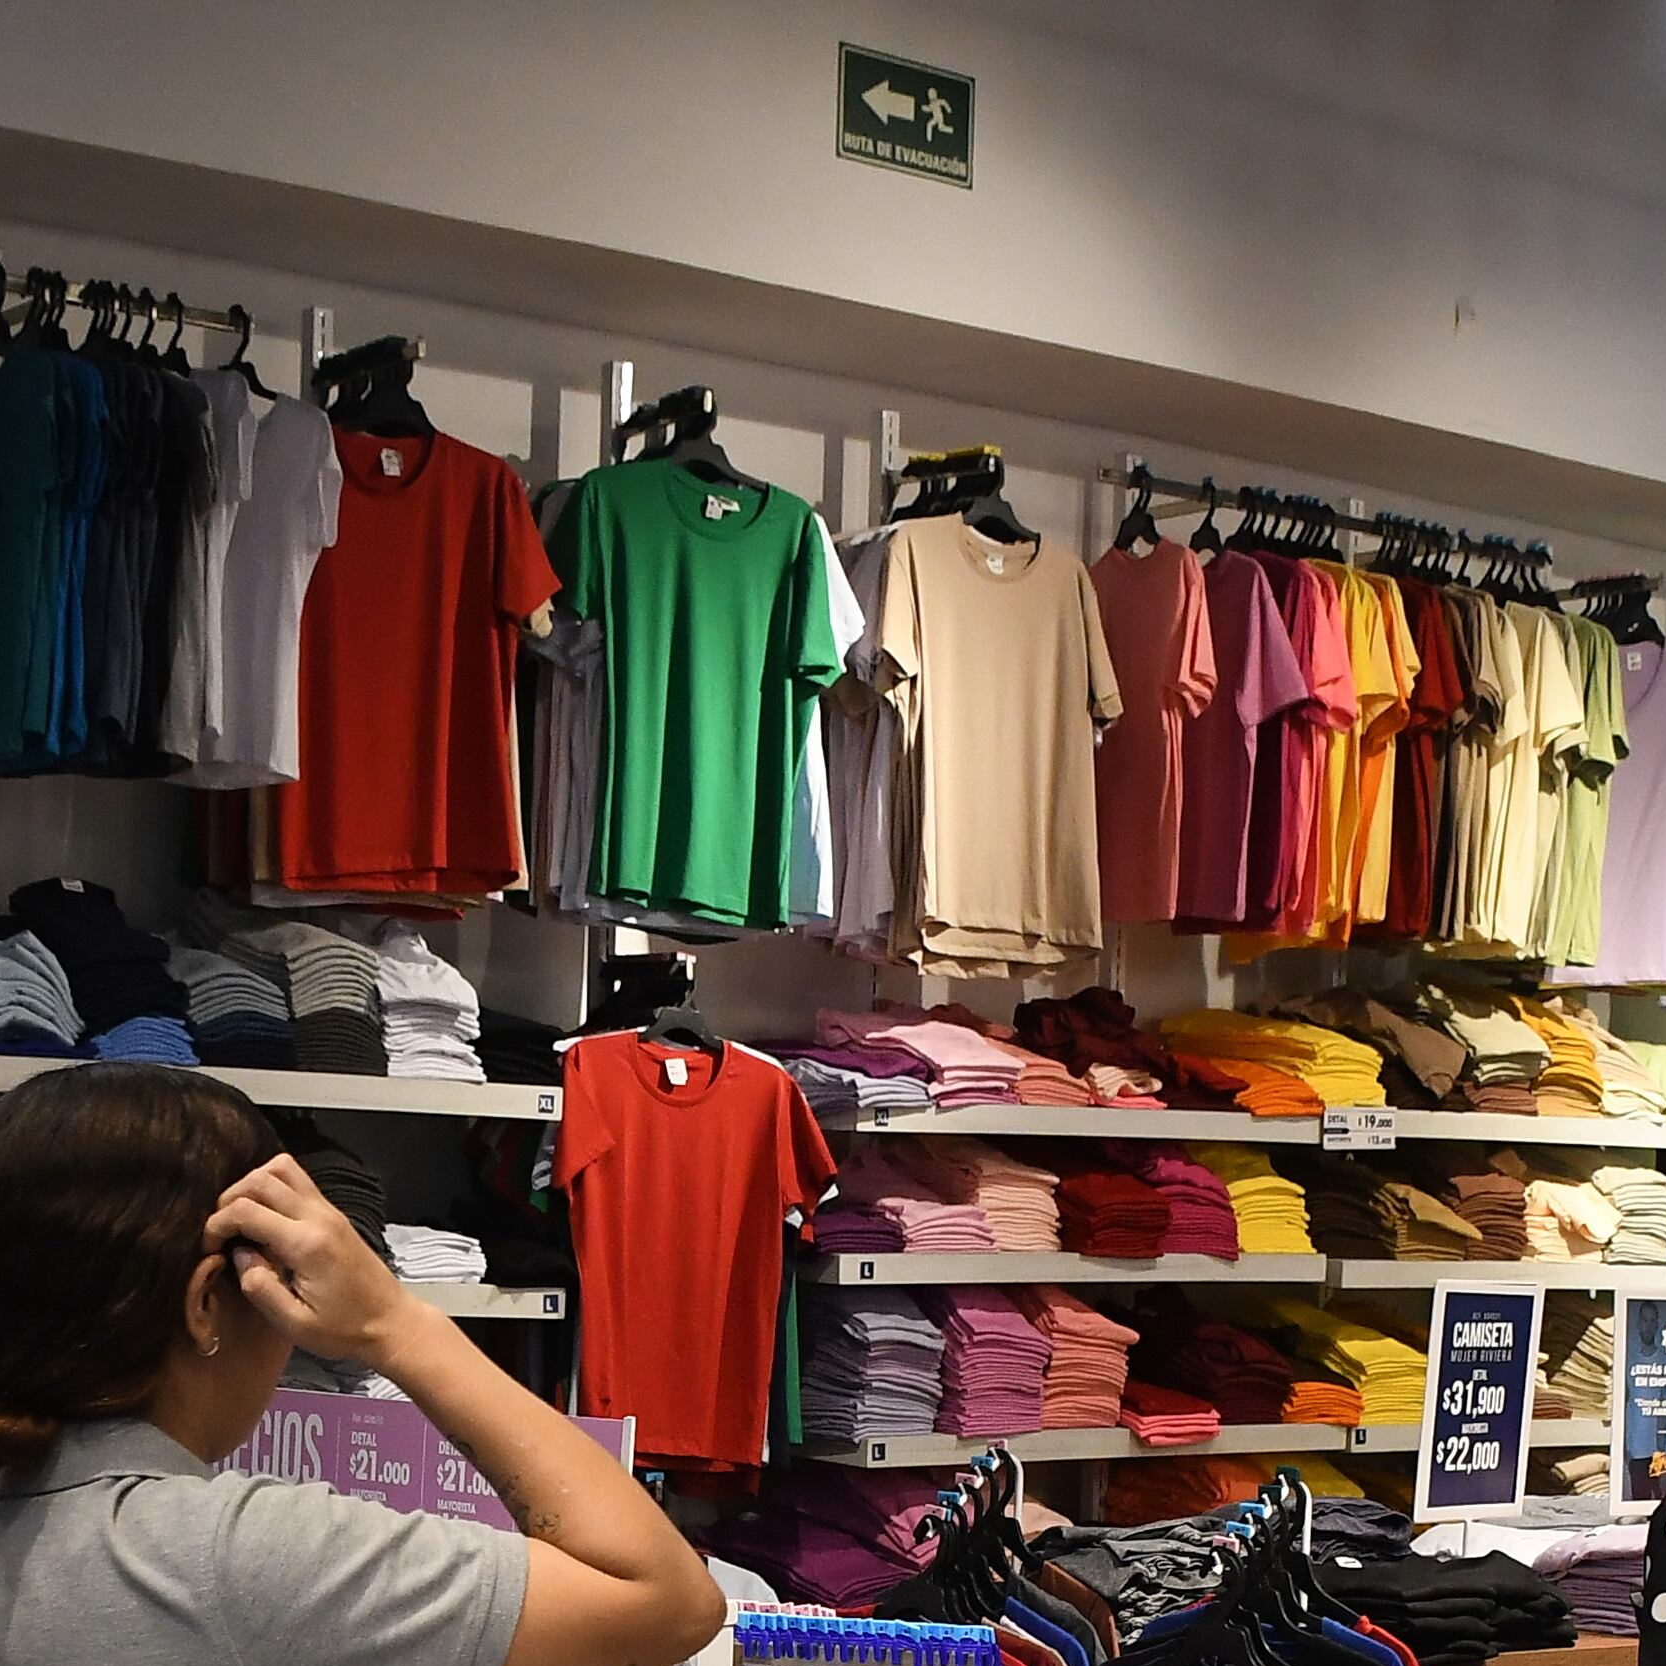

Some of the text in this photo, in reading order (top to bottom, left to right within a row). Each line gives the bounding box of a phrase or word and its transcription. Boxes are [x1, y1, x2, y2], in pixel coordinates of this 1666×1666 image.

[844, 133, 875, 153] RUTA
[876, 141, 893, 158] DE
[539, 1097, 553, 1109] XL
[876, 1111, 889, 1123] XL
[546, 1298, 553, 1311] L
[1453, 1322, 1513, 1348] CAMISETA
[1451, 1350, 1512, 1362] MUJER RIVIERA
[1442, 1380, 1506, 1419] $31,900
[351, 1432, 377, 1447] DETAL
[1436, 1436, 1500, 1475] $22,000
[350, 1449, 410, 1486] $21.000
[438, 1499, 476, 1514] MAYORISTA
